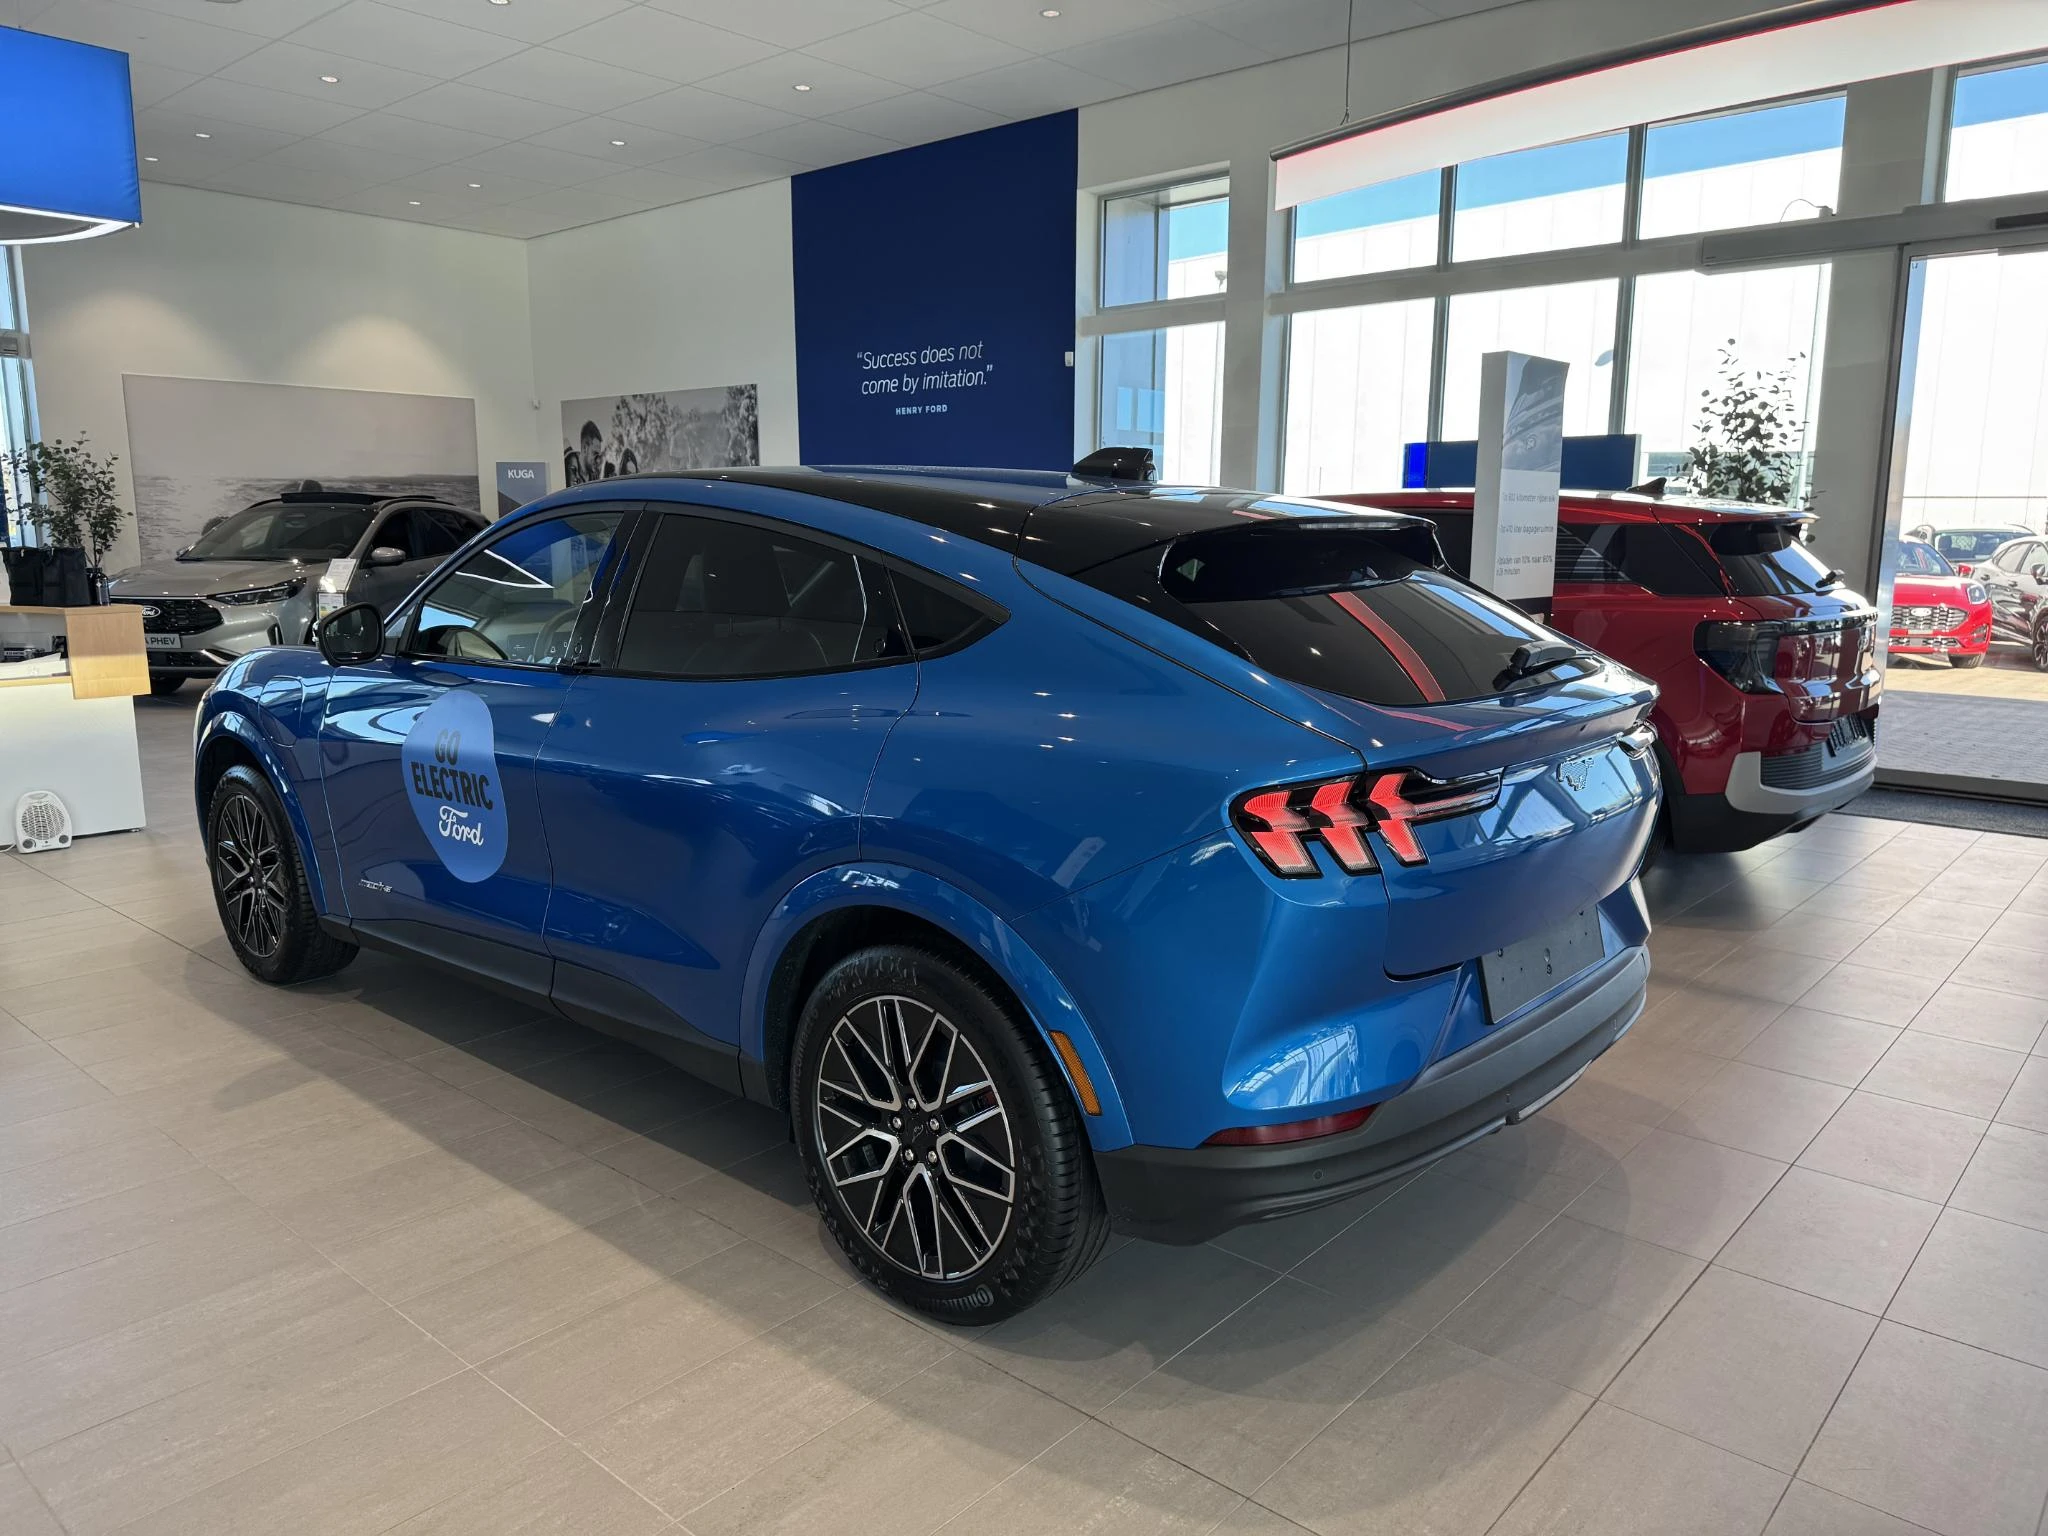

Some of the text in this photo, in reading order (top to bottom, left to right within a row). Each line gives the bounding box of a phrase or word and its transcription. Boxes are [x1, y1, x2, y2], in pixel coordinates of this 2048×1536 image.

[857, 341, 984, 370] “Success does not
[861, 378, 899, 395] come
[902, 373, 919, 395] by
[895, 404, 948, 416] HENRY FORD
[507, 469, 535, 479] KUGA
[150, 637, 176, 645] PHEV
[434, 729, 461, 766] GO
[411, 761, 494, 811] ELECTRIC
[438, 805, 485, 847] Ford
